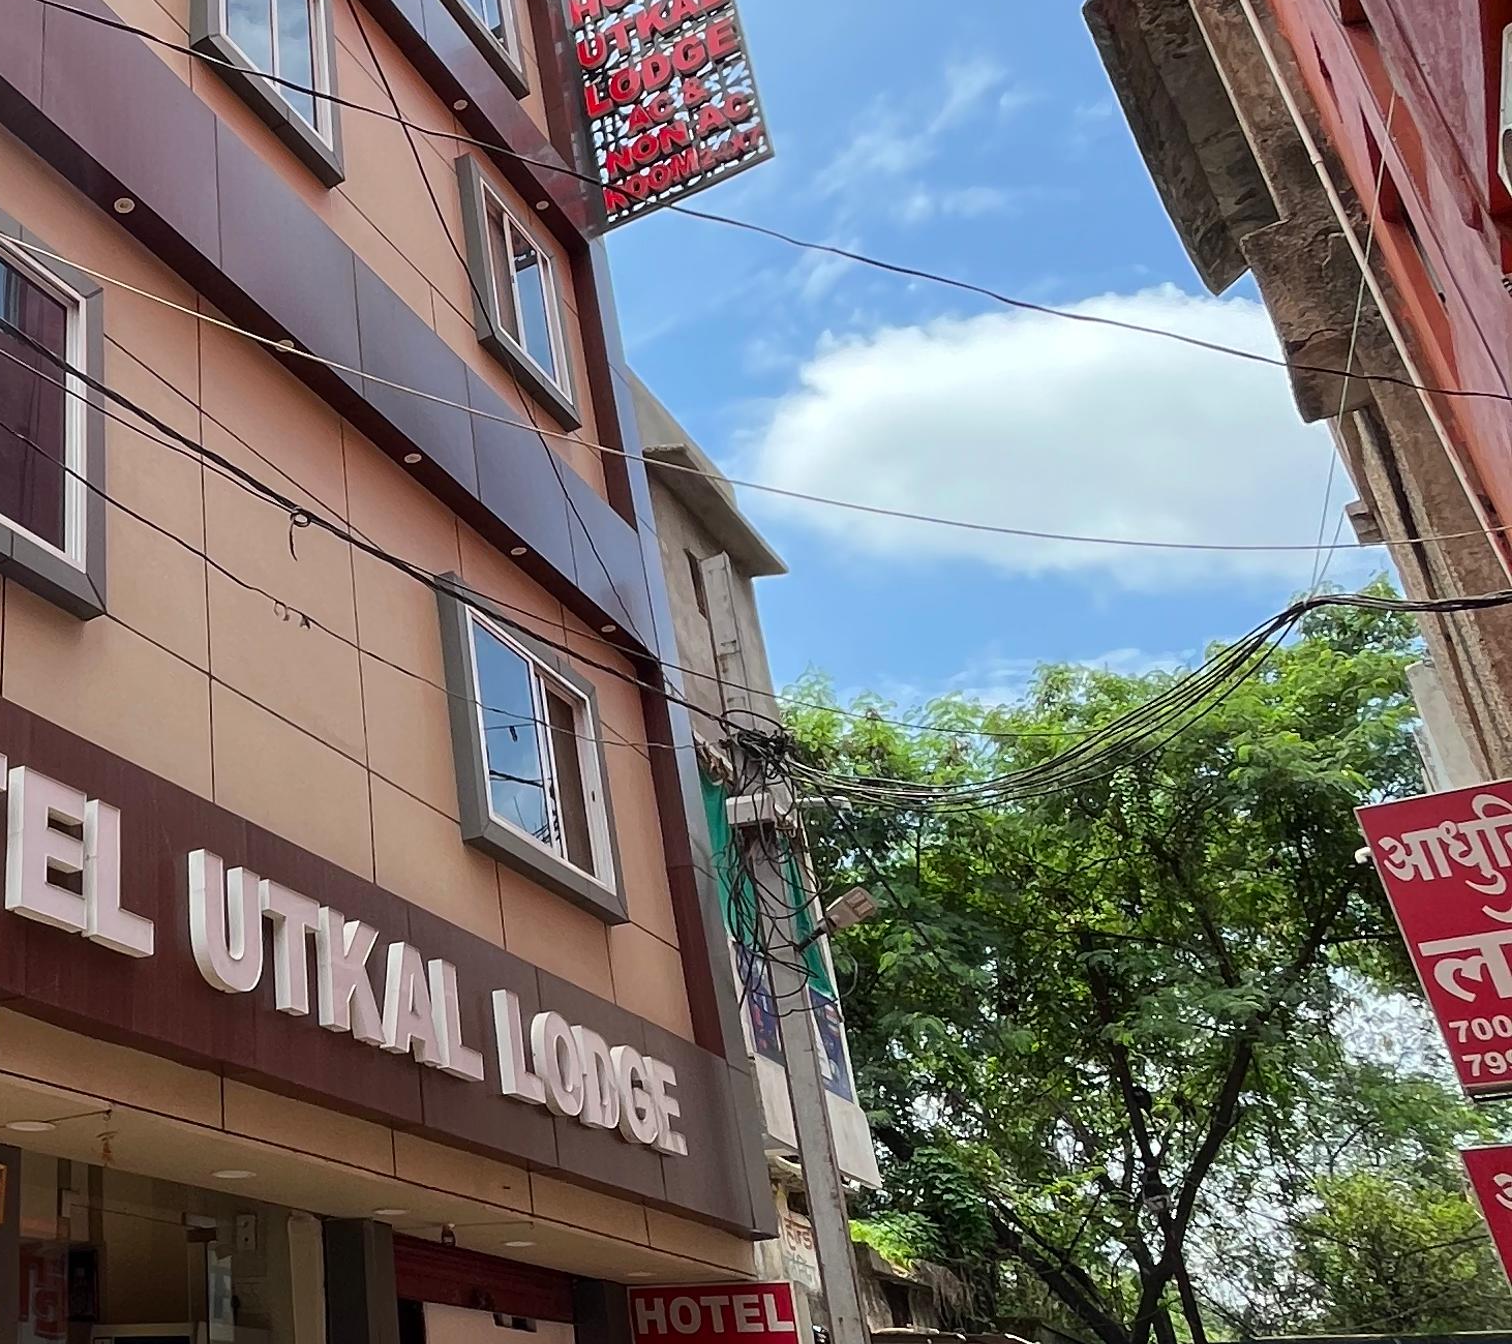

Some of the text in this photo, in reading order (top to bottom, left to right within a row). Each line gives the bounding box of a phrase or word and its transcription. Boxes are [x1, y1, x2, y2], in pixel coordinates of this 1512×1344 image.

[584, 18, 739, 118] LODGE
[626, 76, 709, 137] AC &
[605, 93, 753, 180] NON AC
[188, 847, 485, 1083] UTKAL
[491, 987, 688, 1158] LODGE
[636, 1293, 795, 1336] HOTEL
